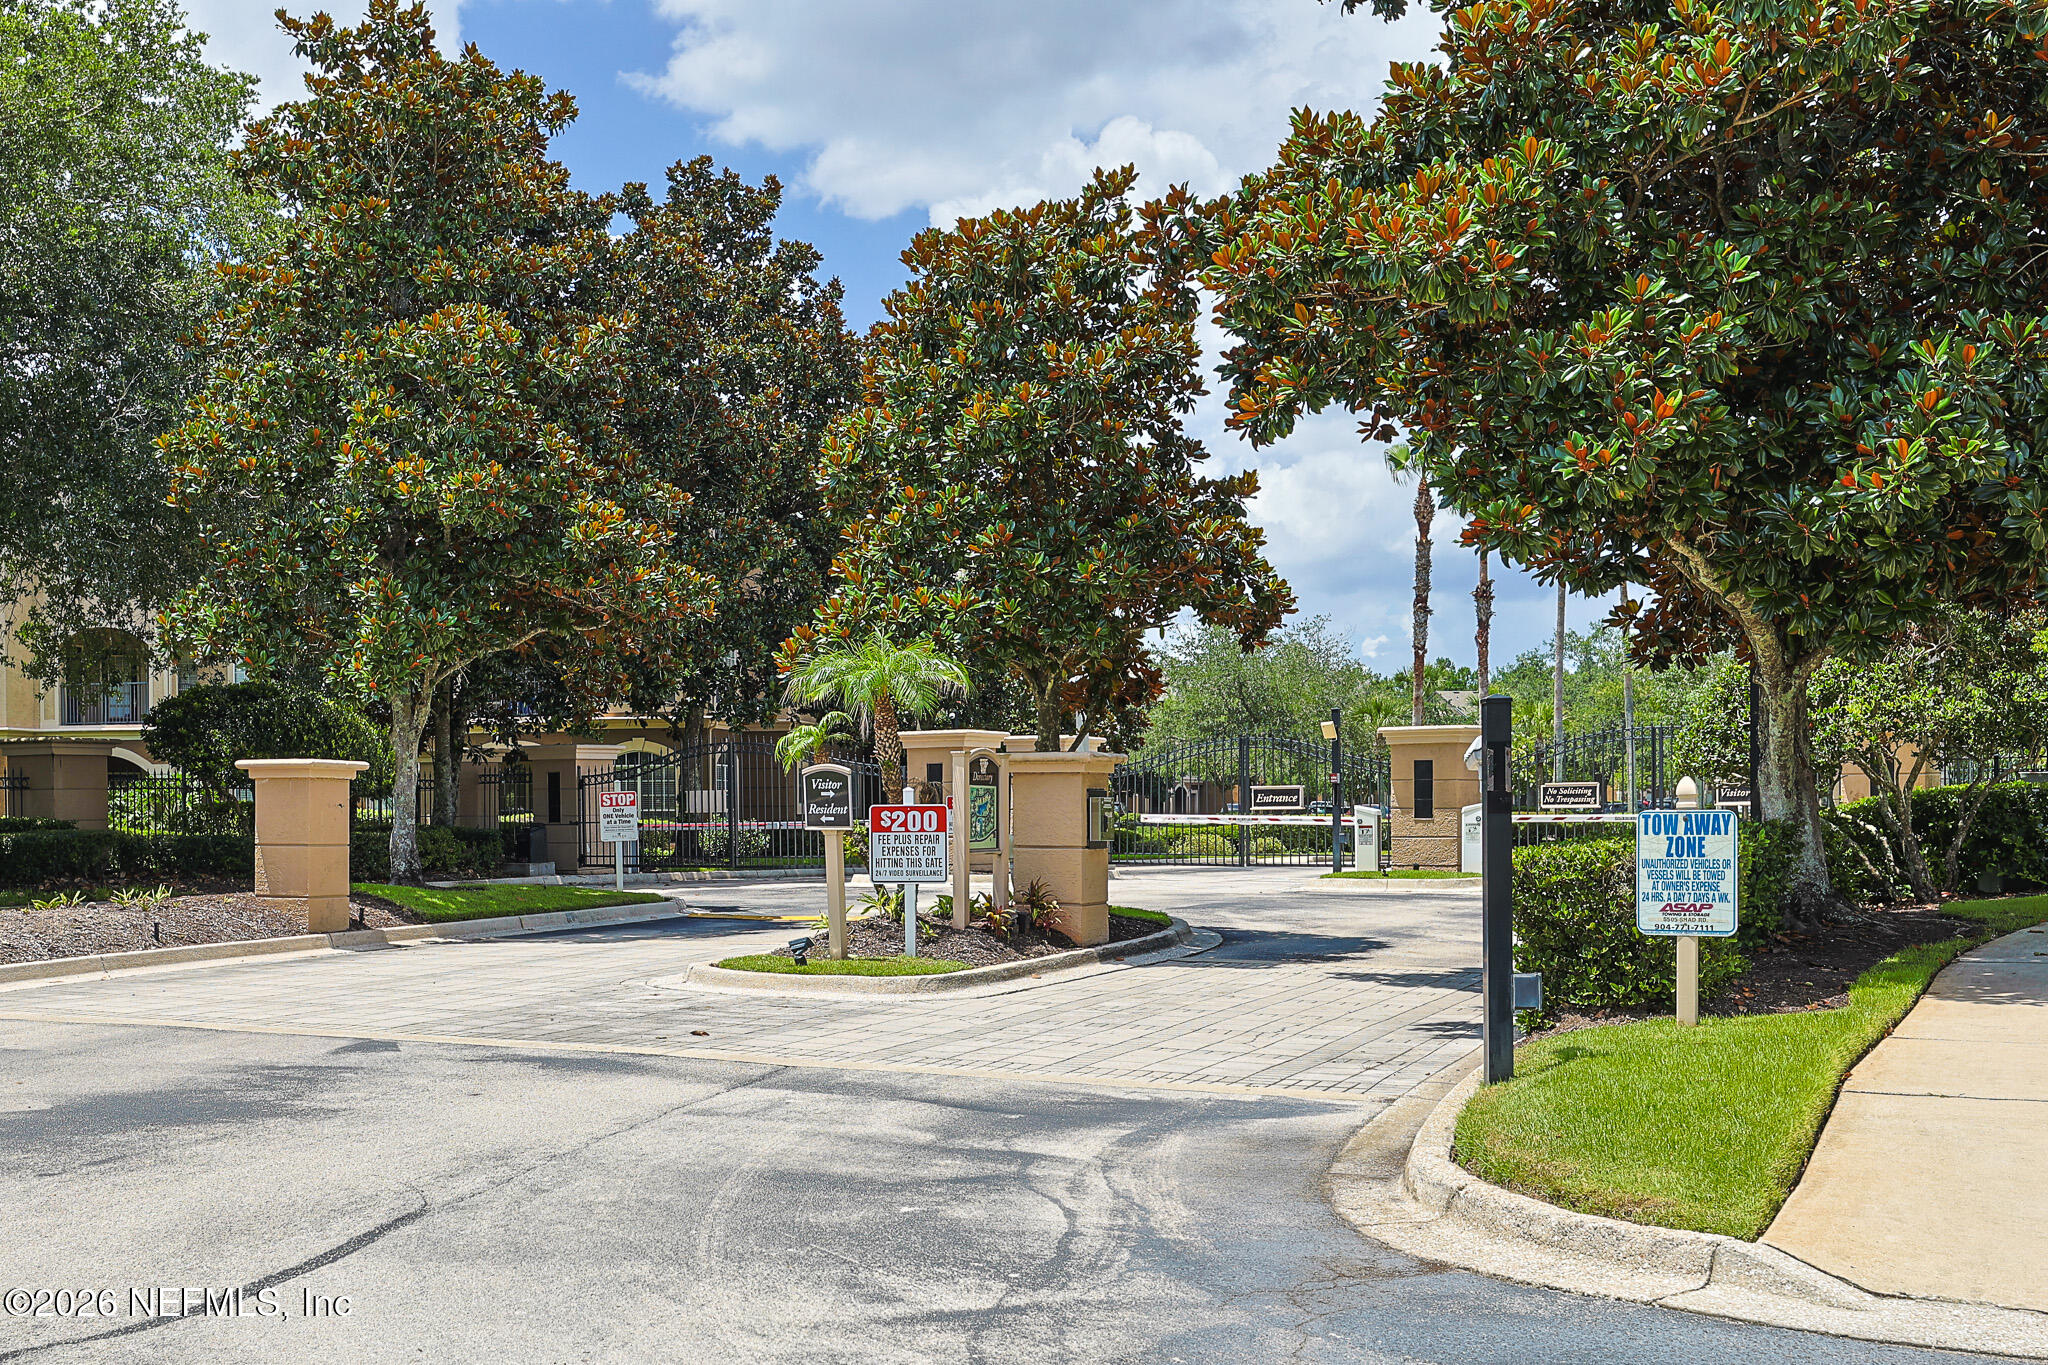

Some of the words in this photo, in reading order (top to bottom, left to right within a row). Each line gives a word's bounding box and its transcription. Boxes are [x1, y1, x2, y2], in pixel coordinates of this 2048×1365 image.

[811, 778, 842, 789] Visitor
[1547, 787, 1557, 795] No
[1559, 787, 1592, 796] Soliciting
[1721, 788, 1751, 797] Visitor
[602, 793, 634, 806] STOP
[1256, 793, 1298, 803] Entrance
[1557, 795, 1595, 804] Trespassing
[808, 803, 848, 815] Resident
[880, 810, 938, 832] $200
[1642, 814, 1678, 835] TOW
[1683, 814, 1732, 835] AWAY
[878, 835, 891, 845] FEE
[894, 835, 912, 845] PLUS
[915, 835, 940, 845] REPAIR
[882, 846, 919, 856] EXPENSES
[923, 846, 936, 856] FOR
[1666, 836, 1706, 857] ZONE
[876, 858, 903, 868] HITTING
[907, 858, 922, 868] THIS
[926, 858, 943, 868] GATE
[1642, 859, 1688, 868] UNAUTHORIZED
[1690, 859, 1720, 869] VEHICLES
[1722, 859, 1731, 869] OR
[1647, 870, 1674, 880] VESSELS
[1676, 870, 1691, 880] WILL
[1693, 870, 1701, 880] BE
[1703, 870, 1726, 880] TOWED
[1652, 881, 1660, 891] AT
[1662, 881, 1690, 891] OWNER'S
[1692, 881, 1720, 891] EXPENSE
[1642, 892, 1650, 902] 24
[1651, 892, 1665, 902] HRS.
[1667, 892, 1672, 902] A
[1674, 892, 1686, 902] DAY
[1688, 892, 1692, 902] 7
[1694, 892, 1710, 903] DAYS
[1712, 892, 1717, 903] A
[1718, 892, 1731, 903] WK.
[1659, 903, 1714, 912] ASAP
